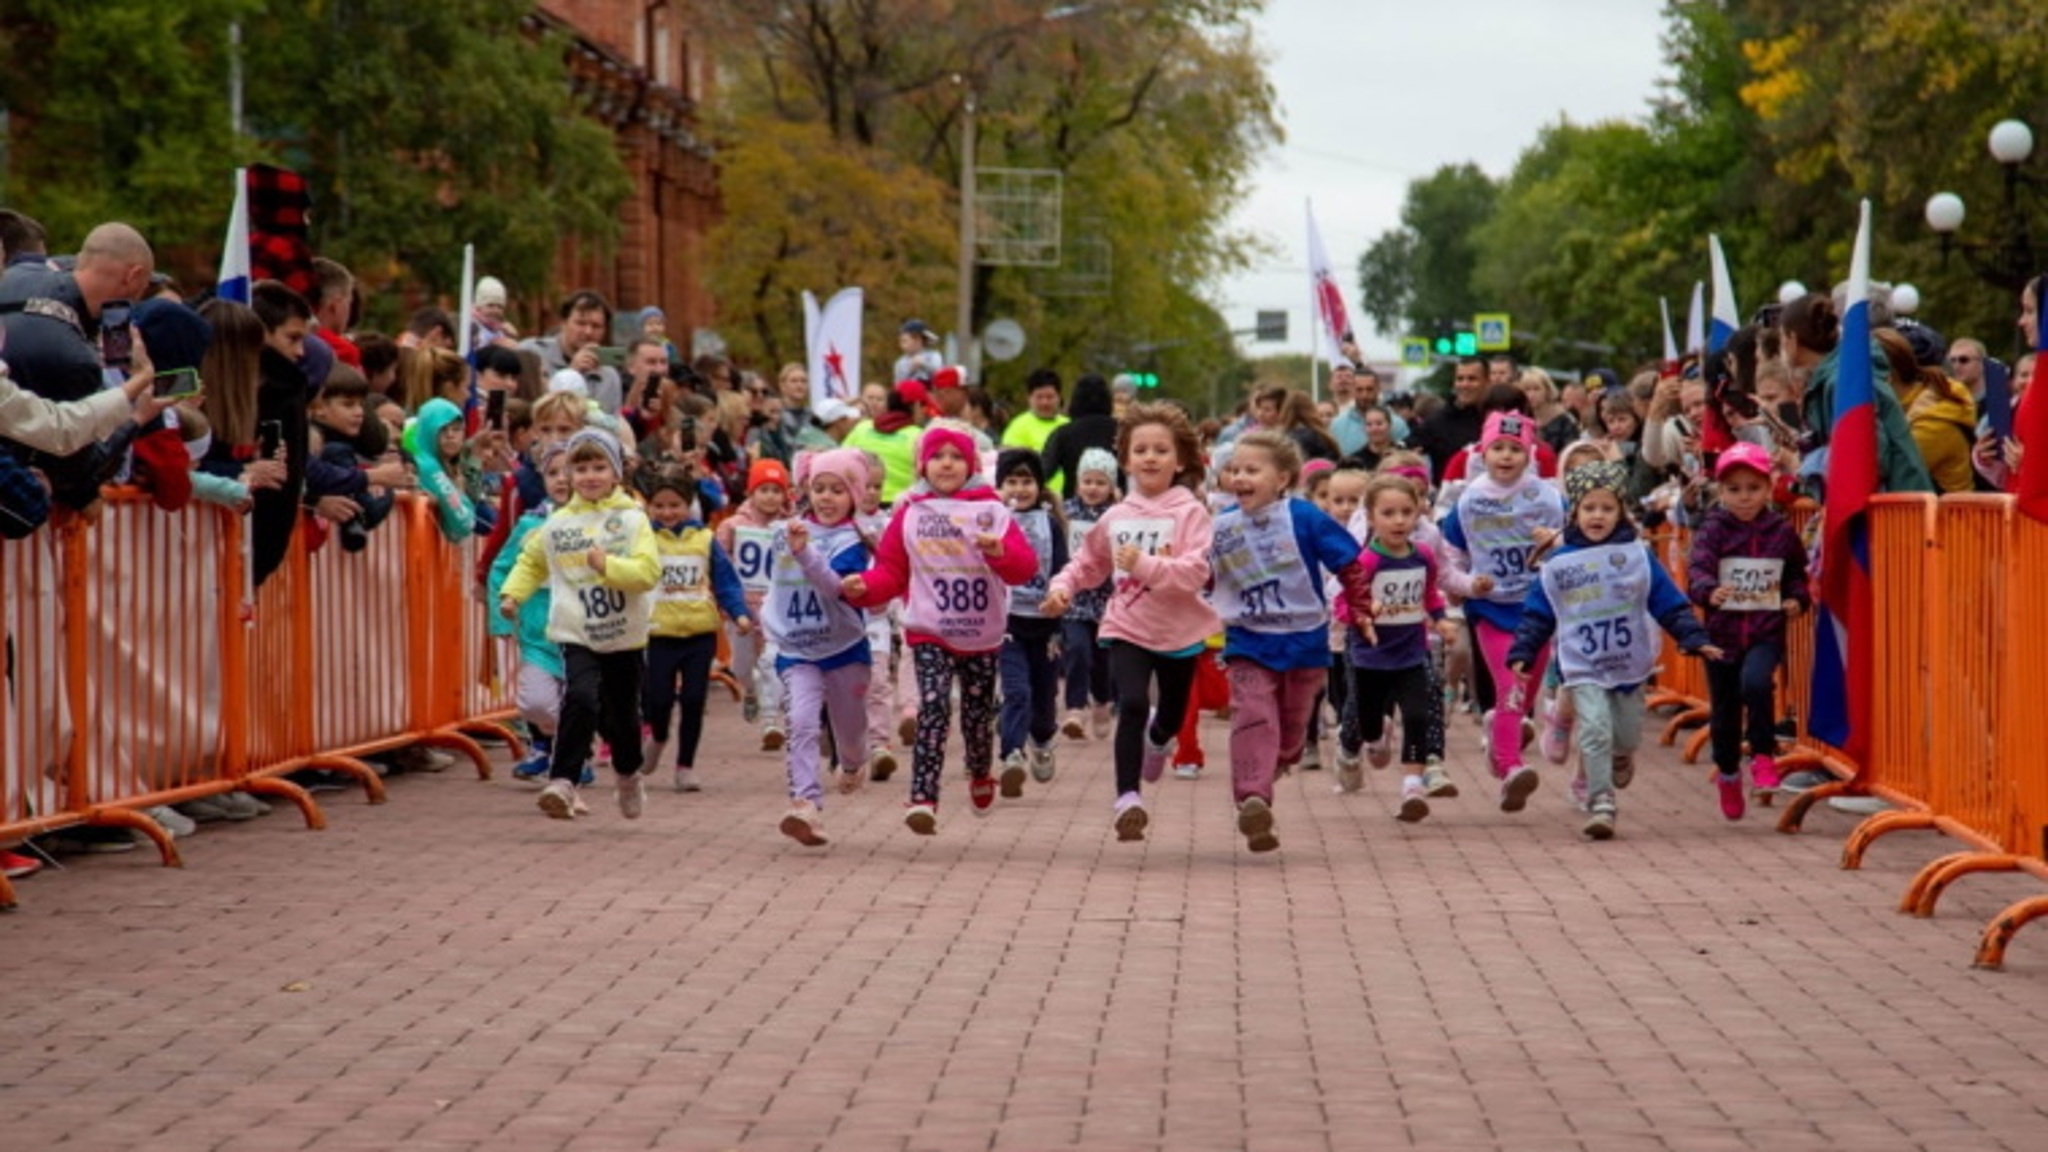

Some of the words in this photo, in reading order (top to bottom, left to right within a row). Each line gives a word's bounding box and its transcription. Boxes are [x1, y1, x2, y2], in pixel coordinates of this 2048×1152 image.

[579, 585, 626, 619] 180
[787, 589, 823, 624] 44
[933, 577, 989, 613] 388
[1578, 616, 1632, 655] 375
